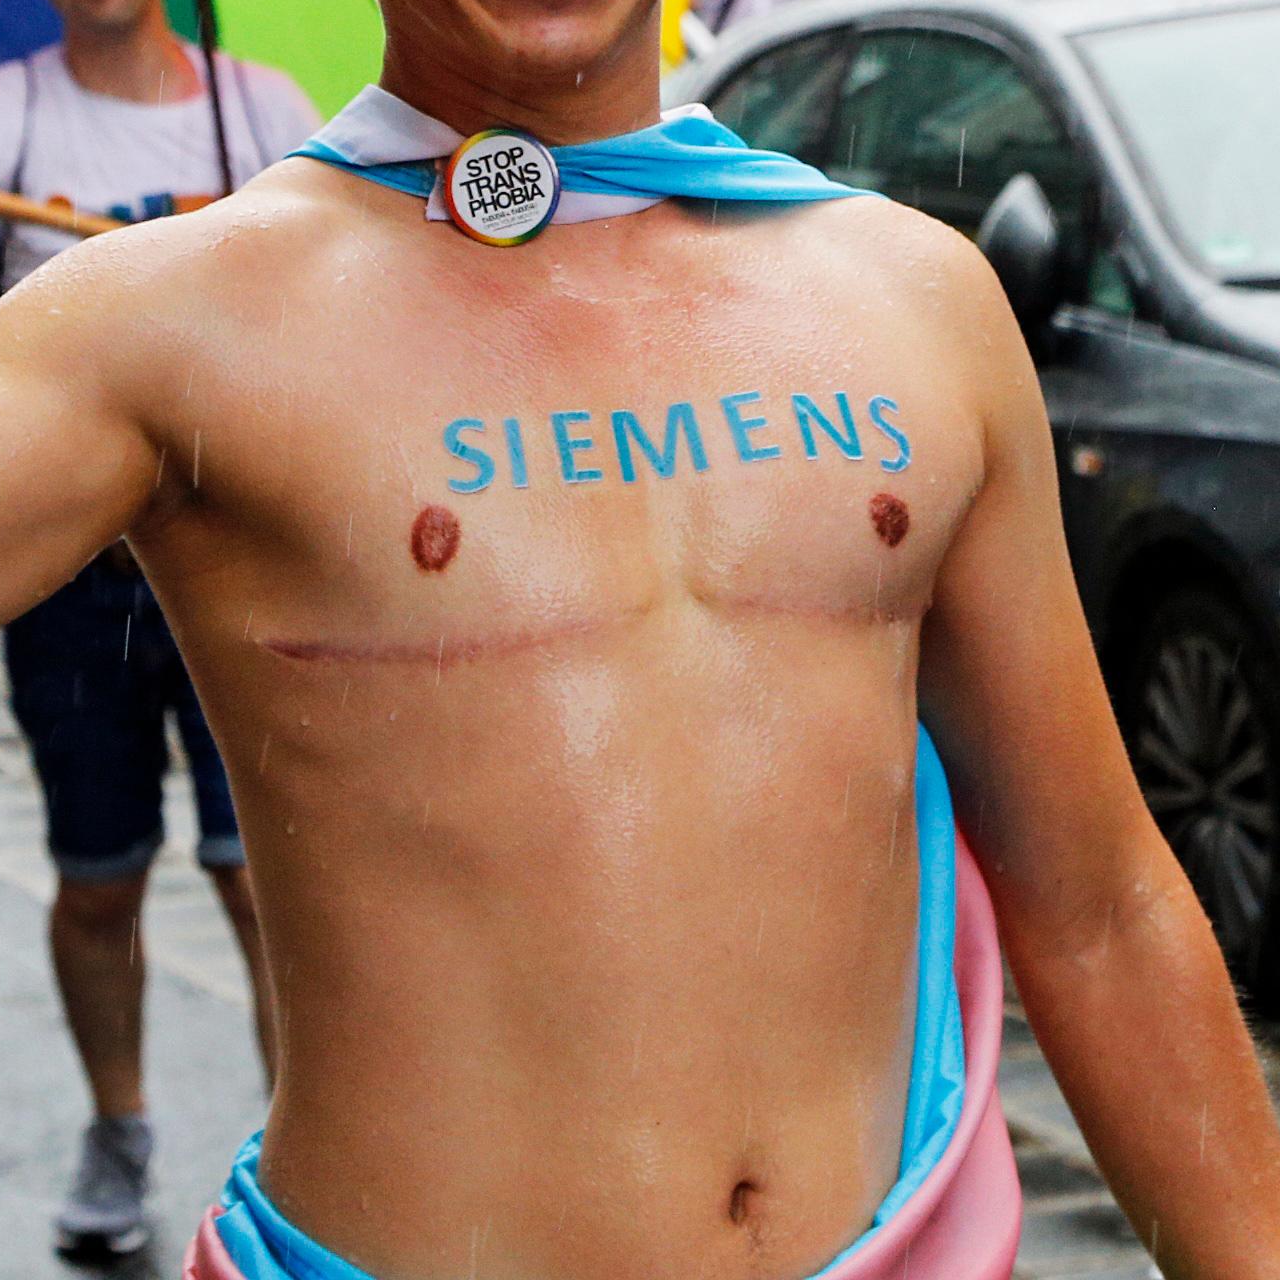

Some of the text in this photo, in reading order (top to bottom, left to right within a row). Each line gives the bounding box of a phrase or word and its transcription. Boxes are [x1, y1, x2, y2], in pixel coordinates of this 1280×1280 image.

[466, 146, 524, 178] STOP
[459, 162, 542, 200] TRANS
[468, 183, 546, 218] PHOBIA
[442, 391, 912, 494] SIEMENS
